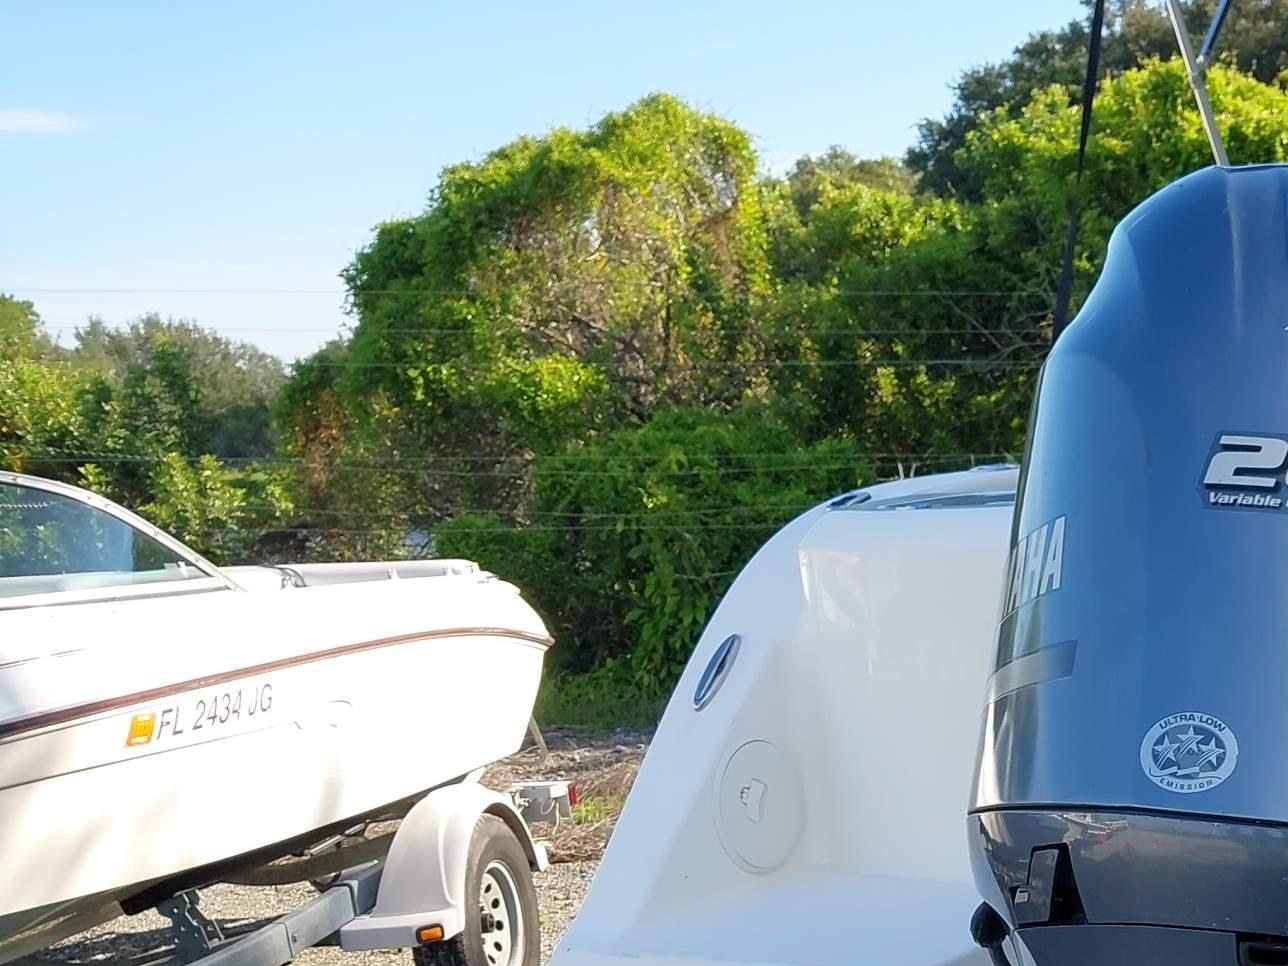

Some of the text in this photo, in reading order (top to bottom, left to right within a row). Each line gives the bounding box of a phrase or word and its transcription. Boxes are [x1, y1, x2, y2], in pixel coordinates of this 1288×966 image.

[1208, 491, 1282, 508] Variable
[156, 706, 184, 740] FL
[191, 689, 242, 730] 2434
[248, 683, 273, 716] JG
[1159, 777, 1214, 791] EMISSION
